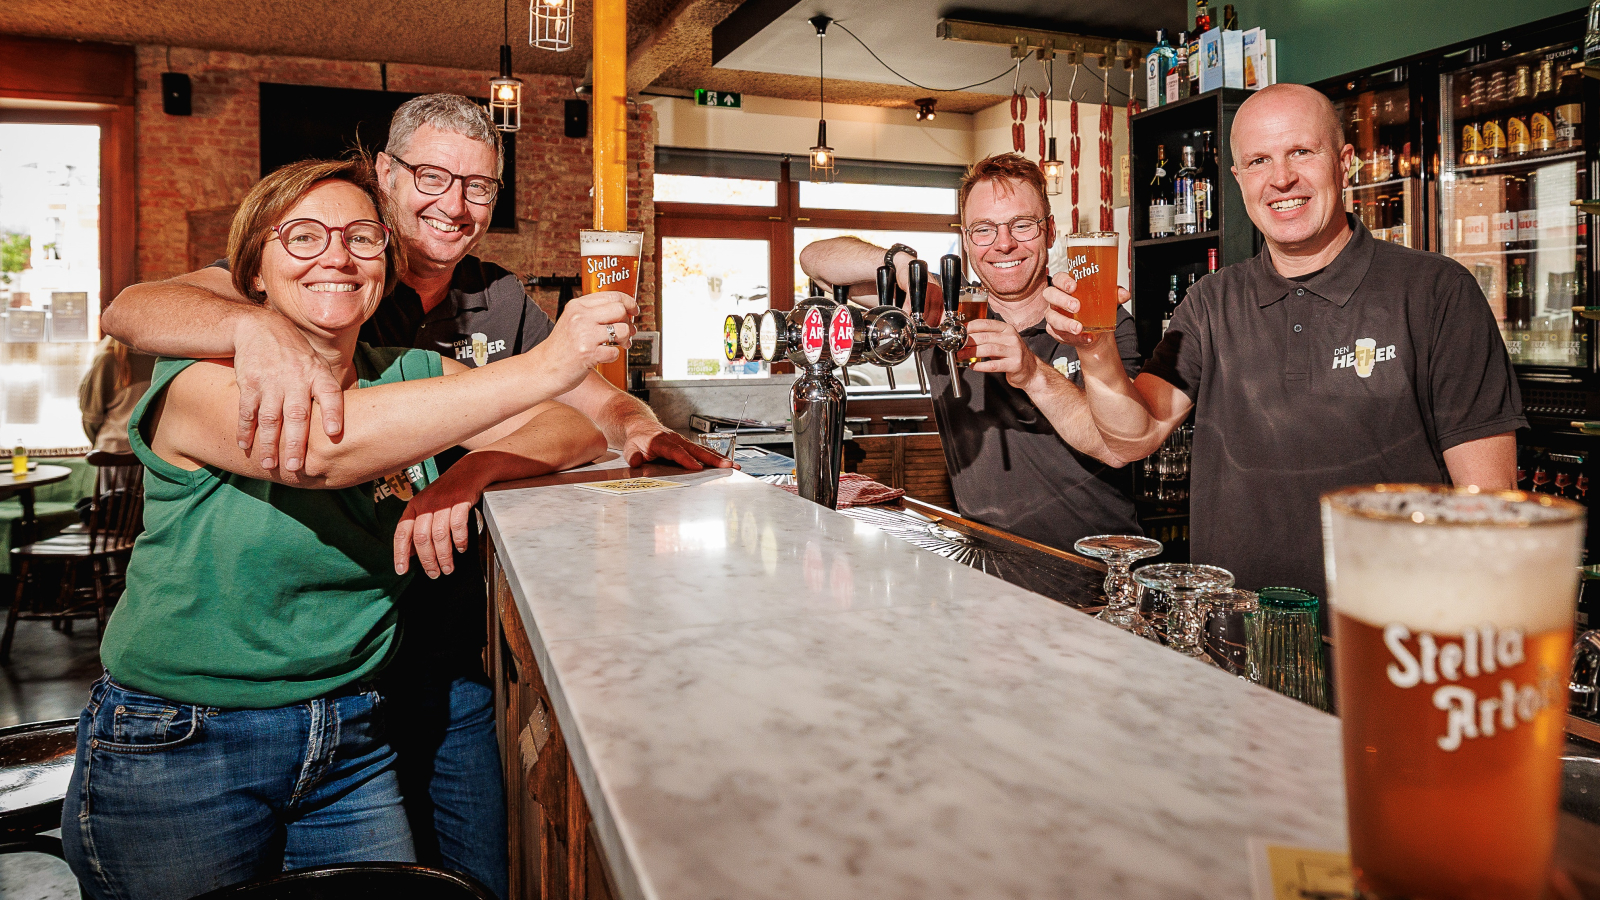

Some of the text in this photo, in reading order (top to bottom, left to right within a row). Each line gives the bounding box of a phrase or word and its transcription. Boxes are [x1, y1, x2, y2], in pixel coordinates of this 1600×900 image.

[587, 256, 618, 274] Stella
[1072, 262, 1100, 282] Artois
[596, 266, 630, 289] Artois
[453, 339, 468, 347] DEN
[455, 339, 506, 360] HEFFER
[1334, 345, 1350, 356] DEN
[1332, 344, 1397, 370] HEFFER
[1383, 622, 1526, 689] Stella
